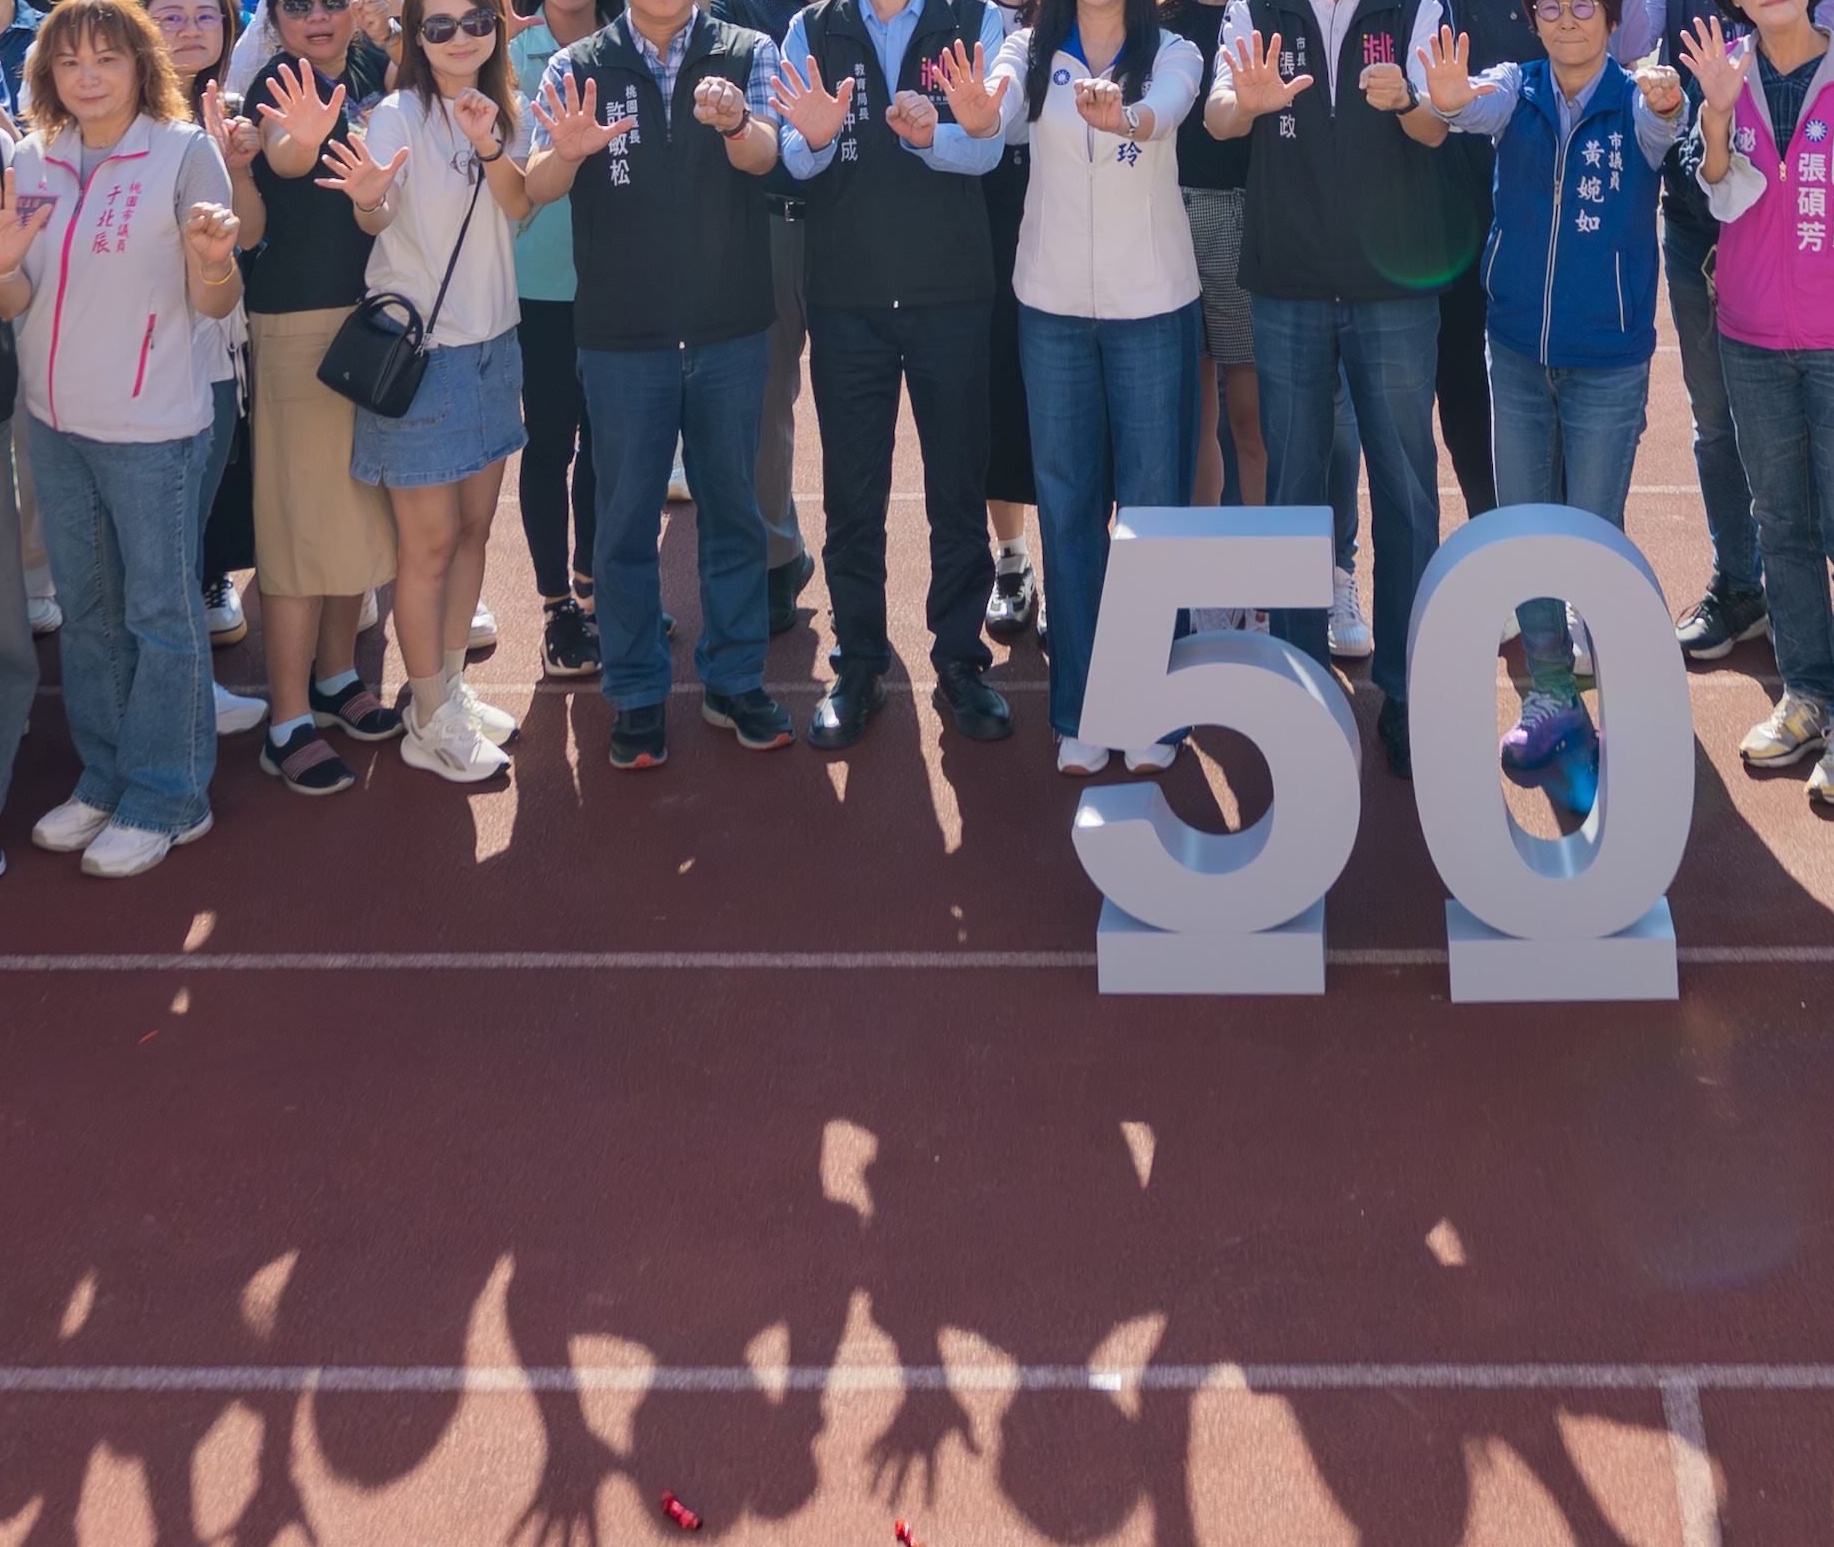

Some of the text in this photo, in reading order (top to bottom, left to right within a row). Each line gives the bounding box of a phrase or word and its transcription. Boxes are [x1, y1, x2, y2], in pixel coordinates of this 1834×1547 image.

[854, 62, 871, 122] 教育局長
[1295, 36, 1307, 67] 市長
[836, 77, 859, 163] 仲成
[1279, 51, 1298, 139] 張政
[605, 100, 631, 186] 許敏松
[1575, 139, 1606, 233] 黃婉如
[1608, 131, 1624, 192] 市議員
[92, 185, 122, 254] 于北辰
[116, 180, 143, 254] 桃園市議員
[1797, 152, 1828, 253] 張碩芳
[1071, 503, 1695, 940] 50
